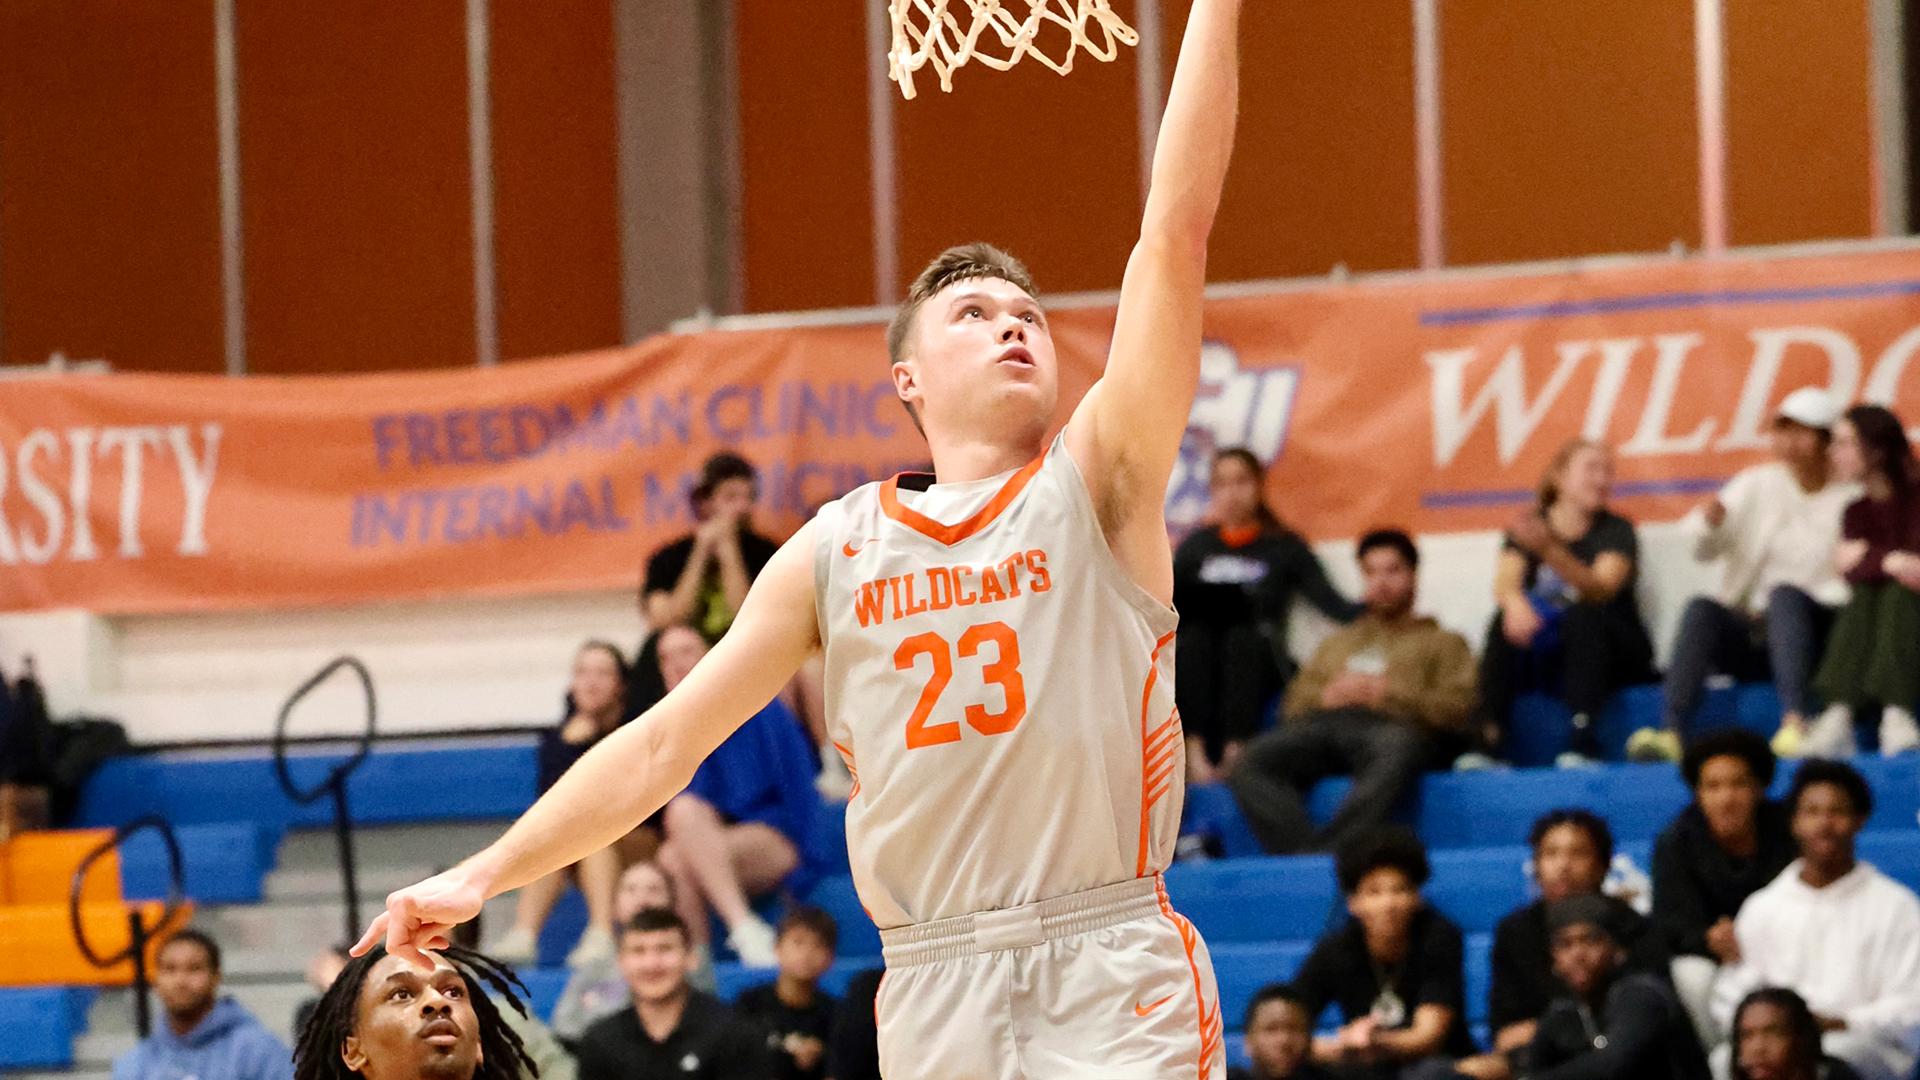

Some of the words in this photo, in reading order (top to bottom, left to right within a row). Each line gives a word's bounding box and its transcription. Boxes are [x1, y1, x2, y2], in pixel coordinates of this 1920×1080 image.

[372, 389, 692, 470] FREEDMAN
[705, 380, 898, 442] CLINIC
[350, 478, 629, 546] INTERNAL
[854, 549, 1051, 628] WILDCATS
[893, 621, 1027, 750] 23
